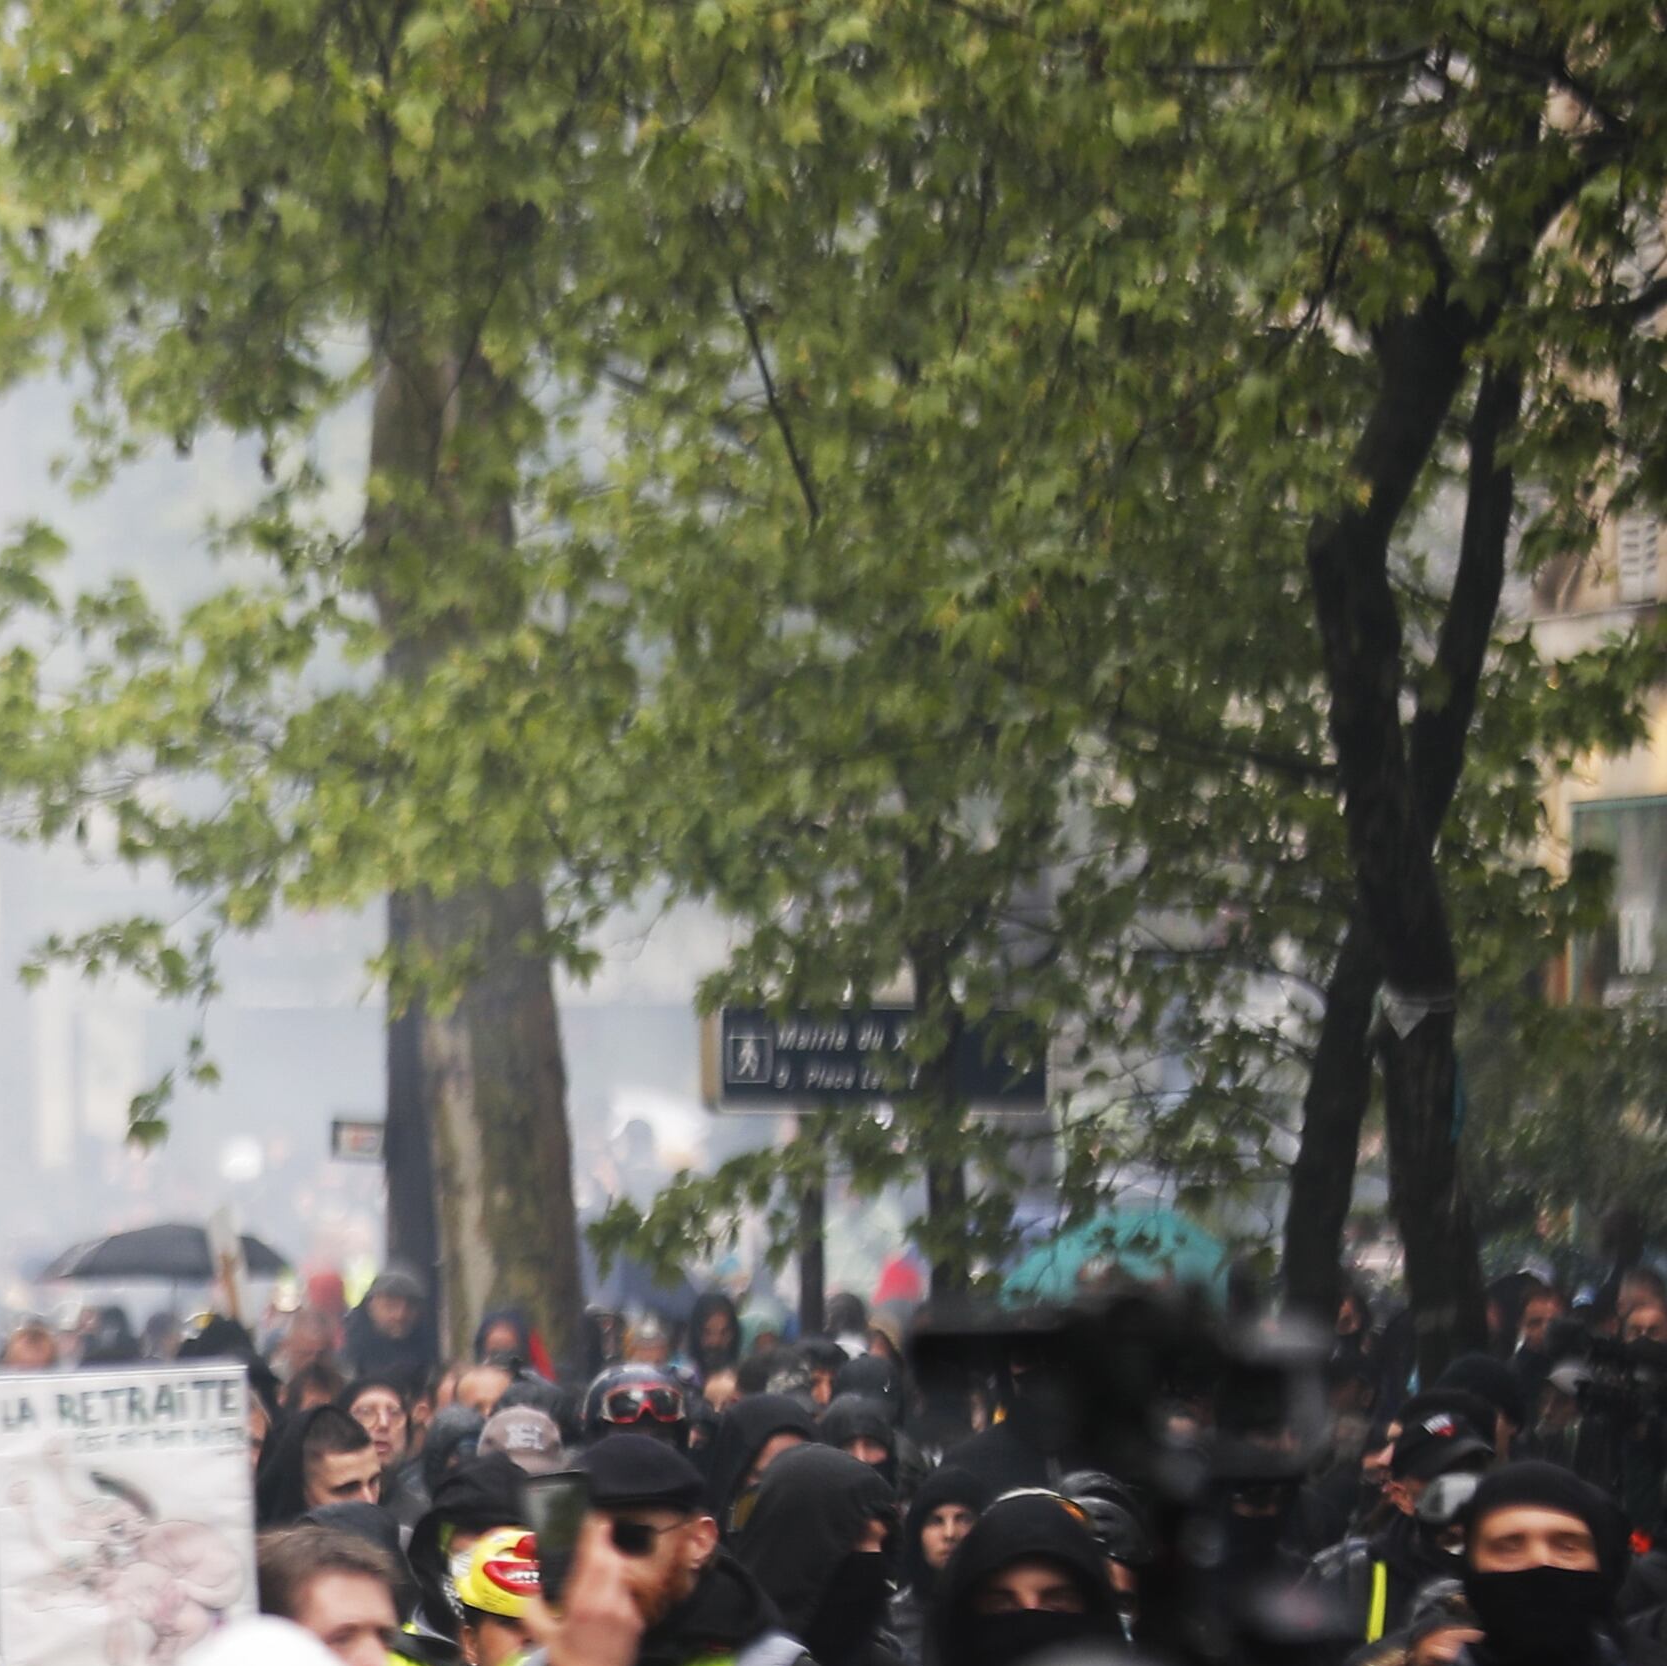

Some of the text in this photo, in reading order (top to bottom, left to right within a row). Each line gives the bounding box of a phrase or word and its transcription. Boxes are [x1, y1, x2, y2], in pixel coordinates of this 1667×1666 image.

[777, 1022, 847, 1051] Mairie
[857, 1020, 884, 1051] du
[804, 1062, 856, 1090] Place
[2, 1397, 37, 1431] LA
